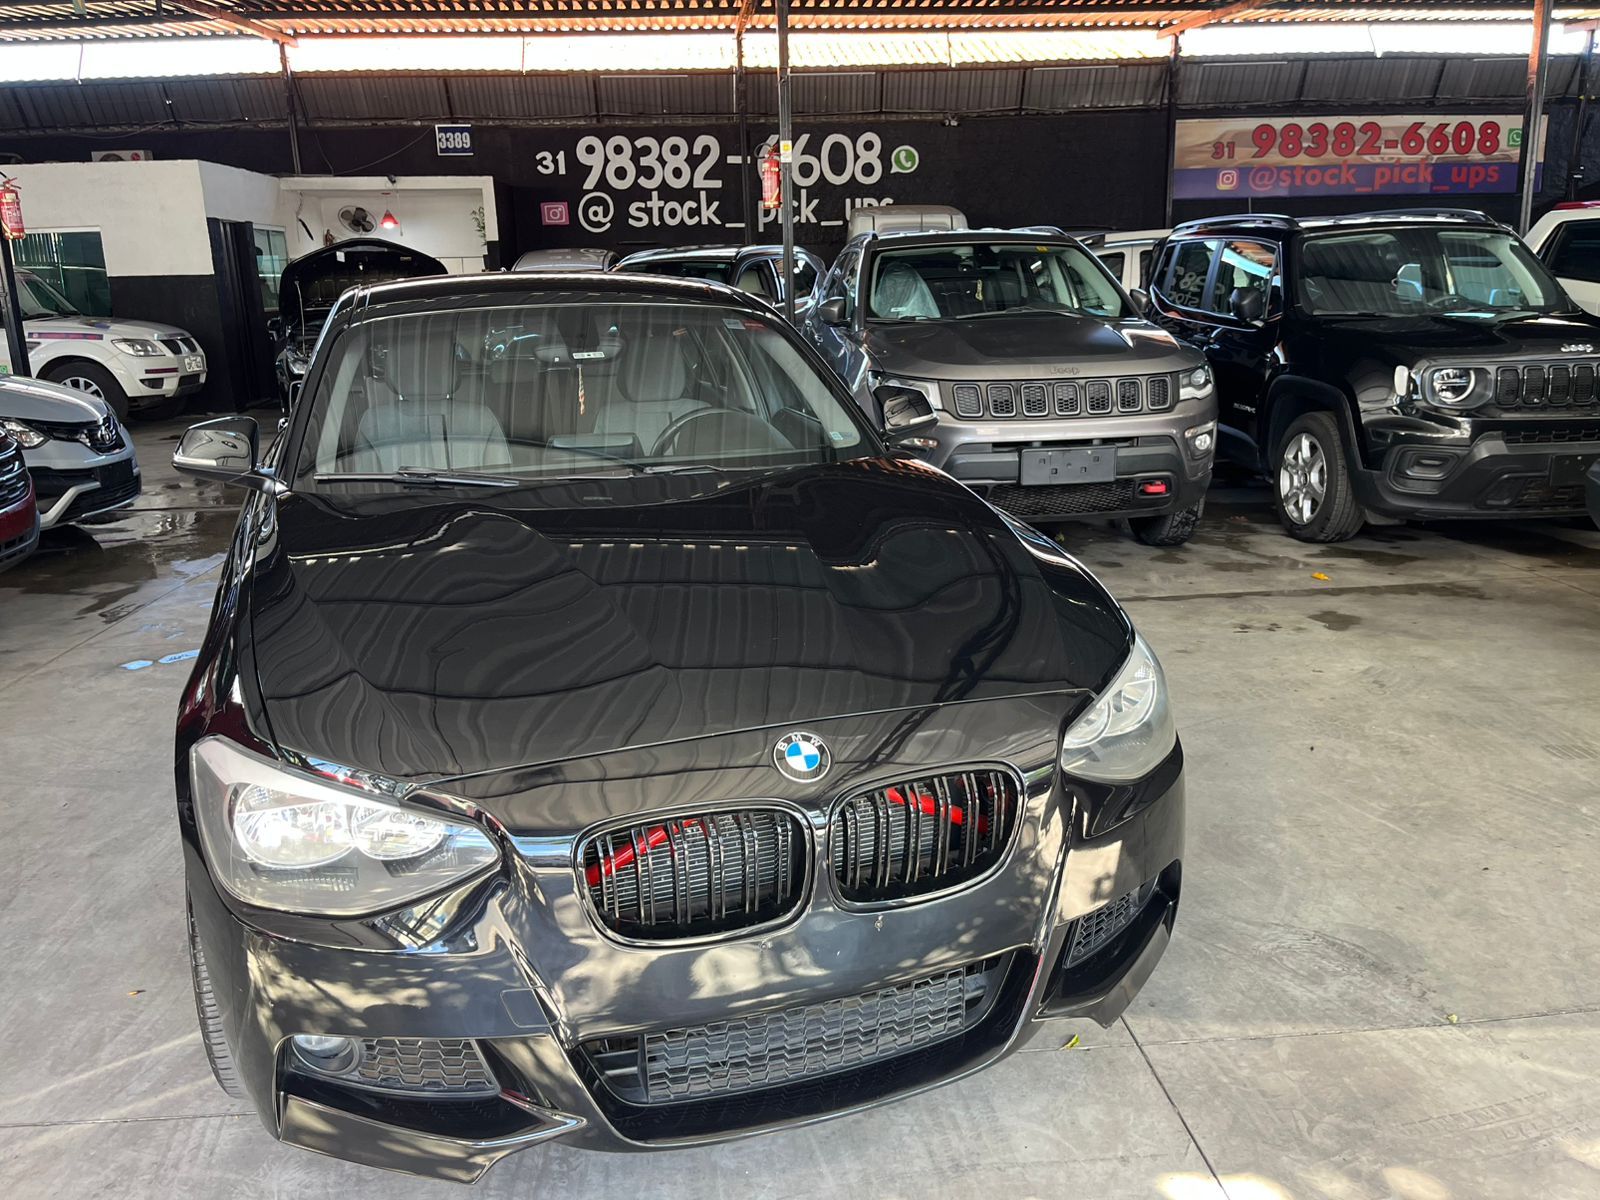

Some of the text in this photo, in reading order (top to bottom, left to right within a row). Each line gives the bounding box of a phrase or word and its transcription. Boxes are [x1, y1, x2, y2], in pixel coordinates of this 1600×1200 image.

[438, 132, 471, 149] 3389
[1211, 121, 1501, 160] 31 98382-6608
[535, 151, 566, 175] 31
[1249, 160, 1500, 192] @stock_pick_ups
